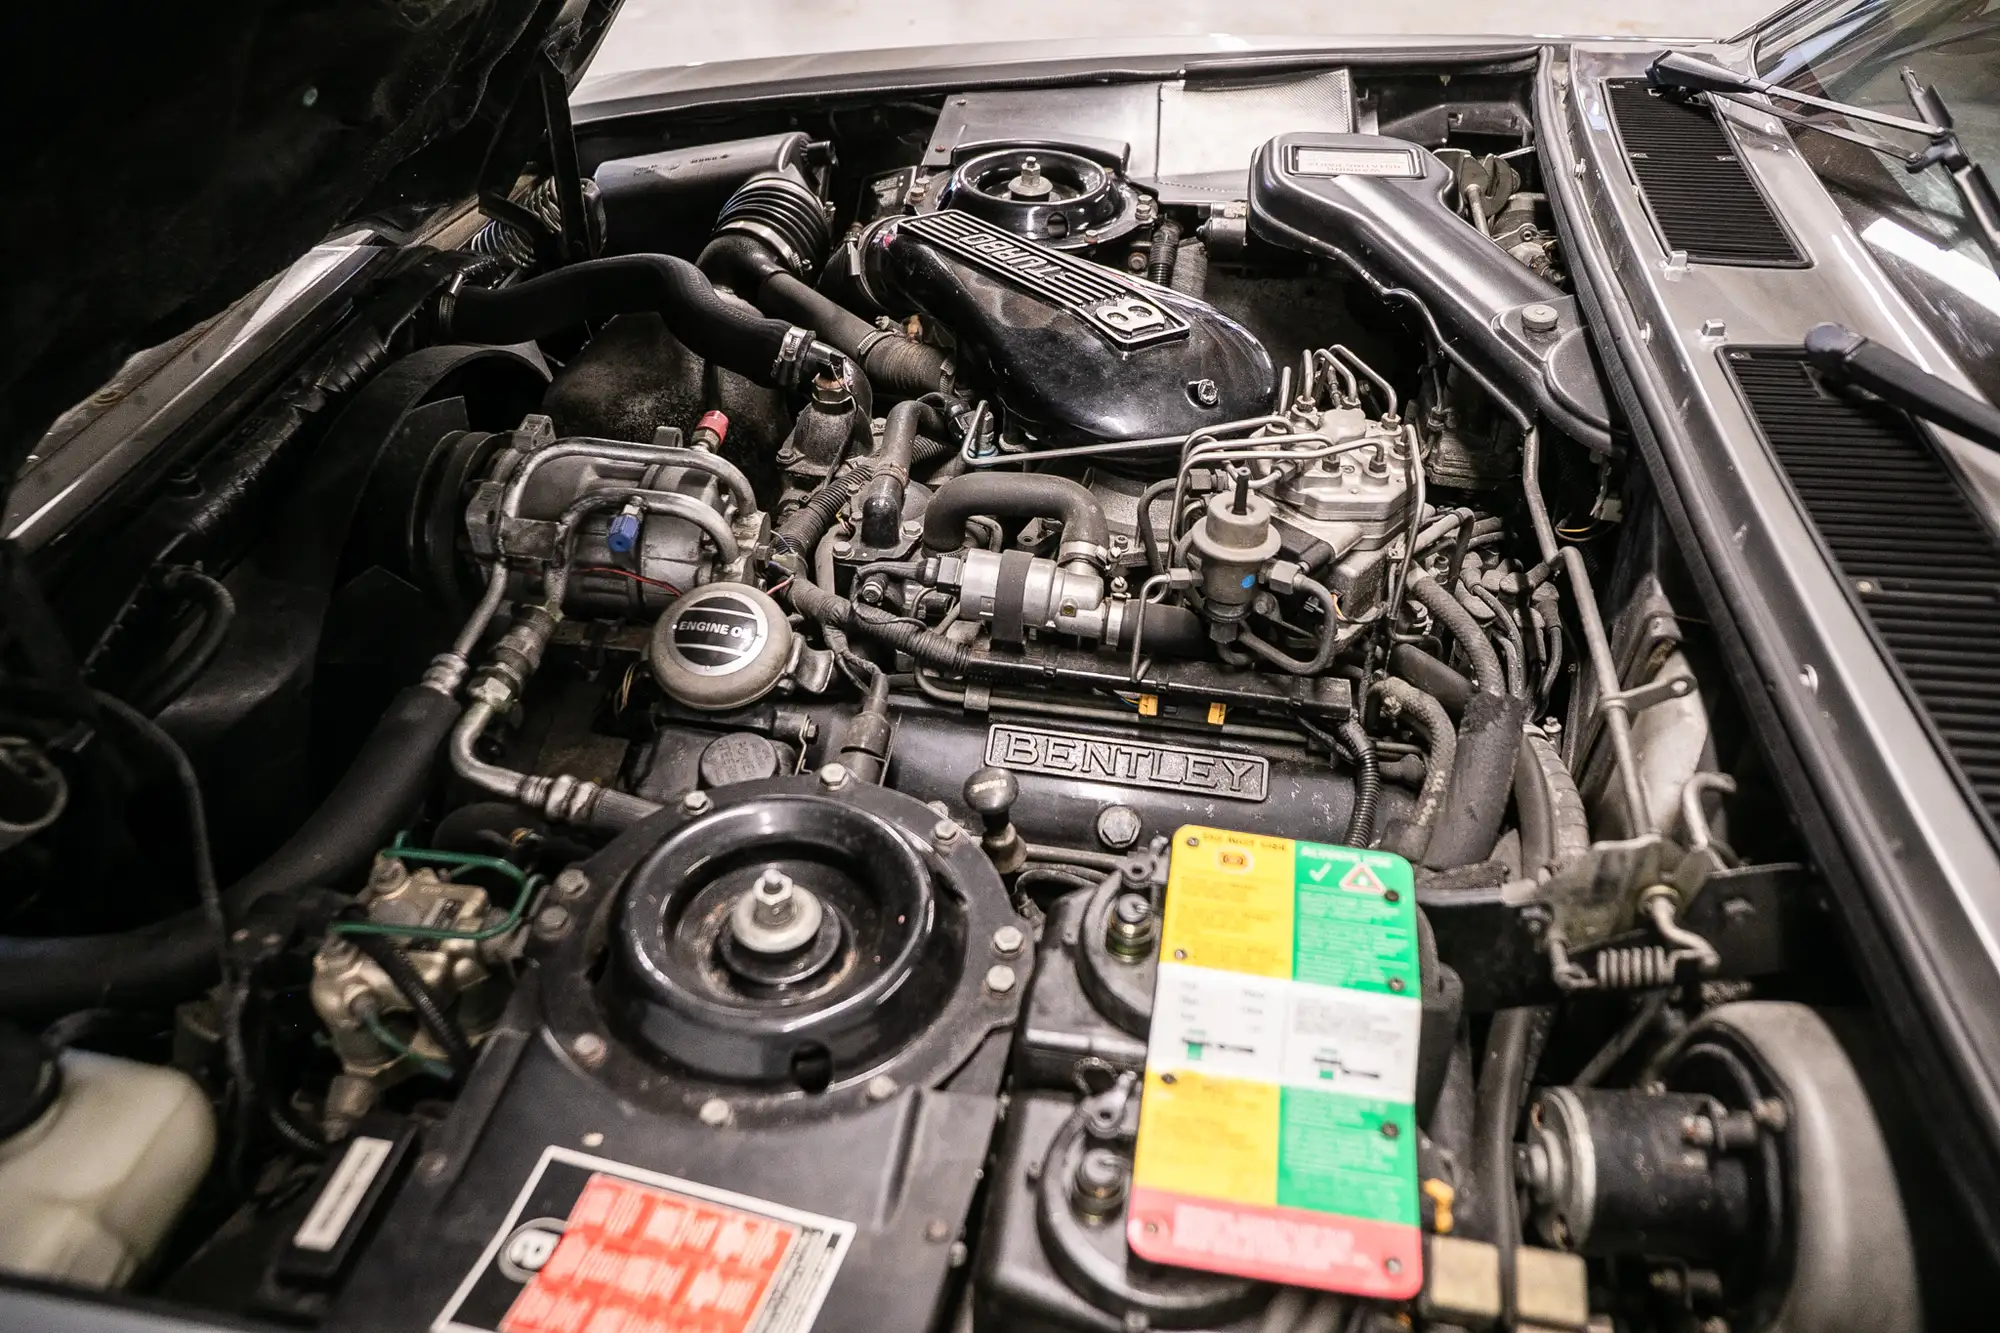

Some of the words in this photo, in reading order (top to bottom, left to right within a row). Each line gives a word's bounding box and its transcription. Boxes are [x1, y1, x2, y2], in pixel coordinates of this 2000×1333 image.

[959, 233, 1063, 280] TURBO
[1096, 299, 1165, 339] B
[678, 621, 730, 635] ENGINE
[1004, 732, 1255, 792] BENTLEY
